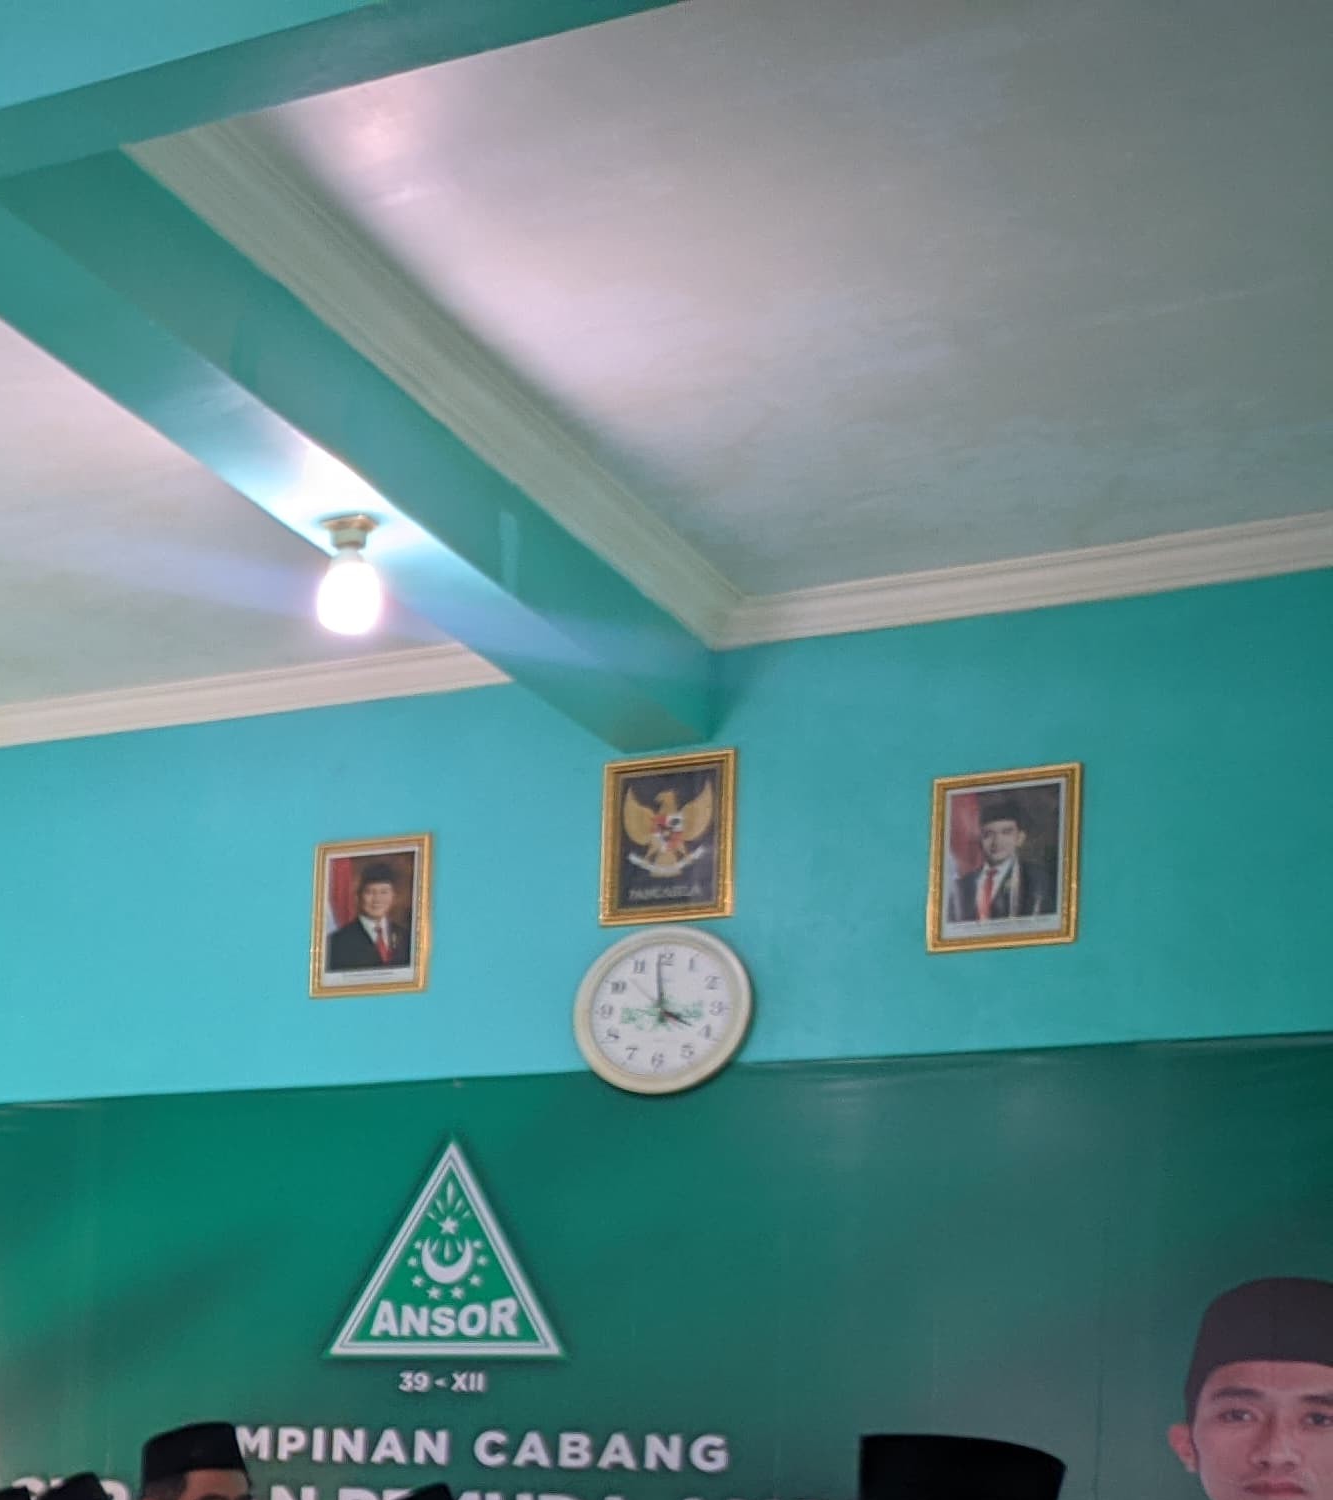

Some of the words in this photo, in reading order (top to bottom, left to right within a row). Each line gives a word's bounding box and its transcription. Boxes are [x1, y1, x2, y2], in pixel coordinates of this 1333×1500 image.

[370, 1298, 519, 1337] ANSOR
[398, 1371, 430, 1393] 39
[450, 1371, 485, 1393] XII
[234, 1425, 450, 1466] MPINAN
[473, 1429, 730, 1473] CABANG
